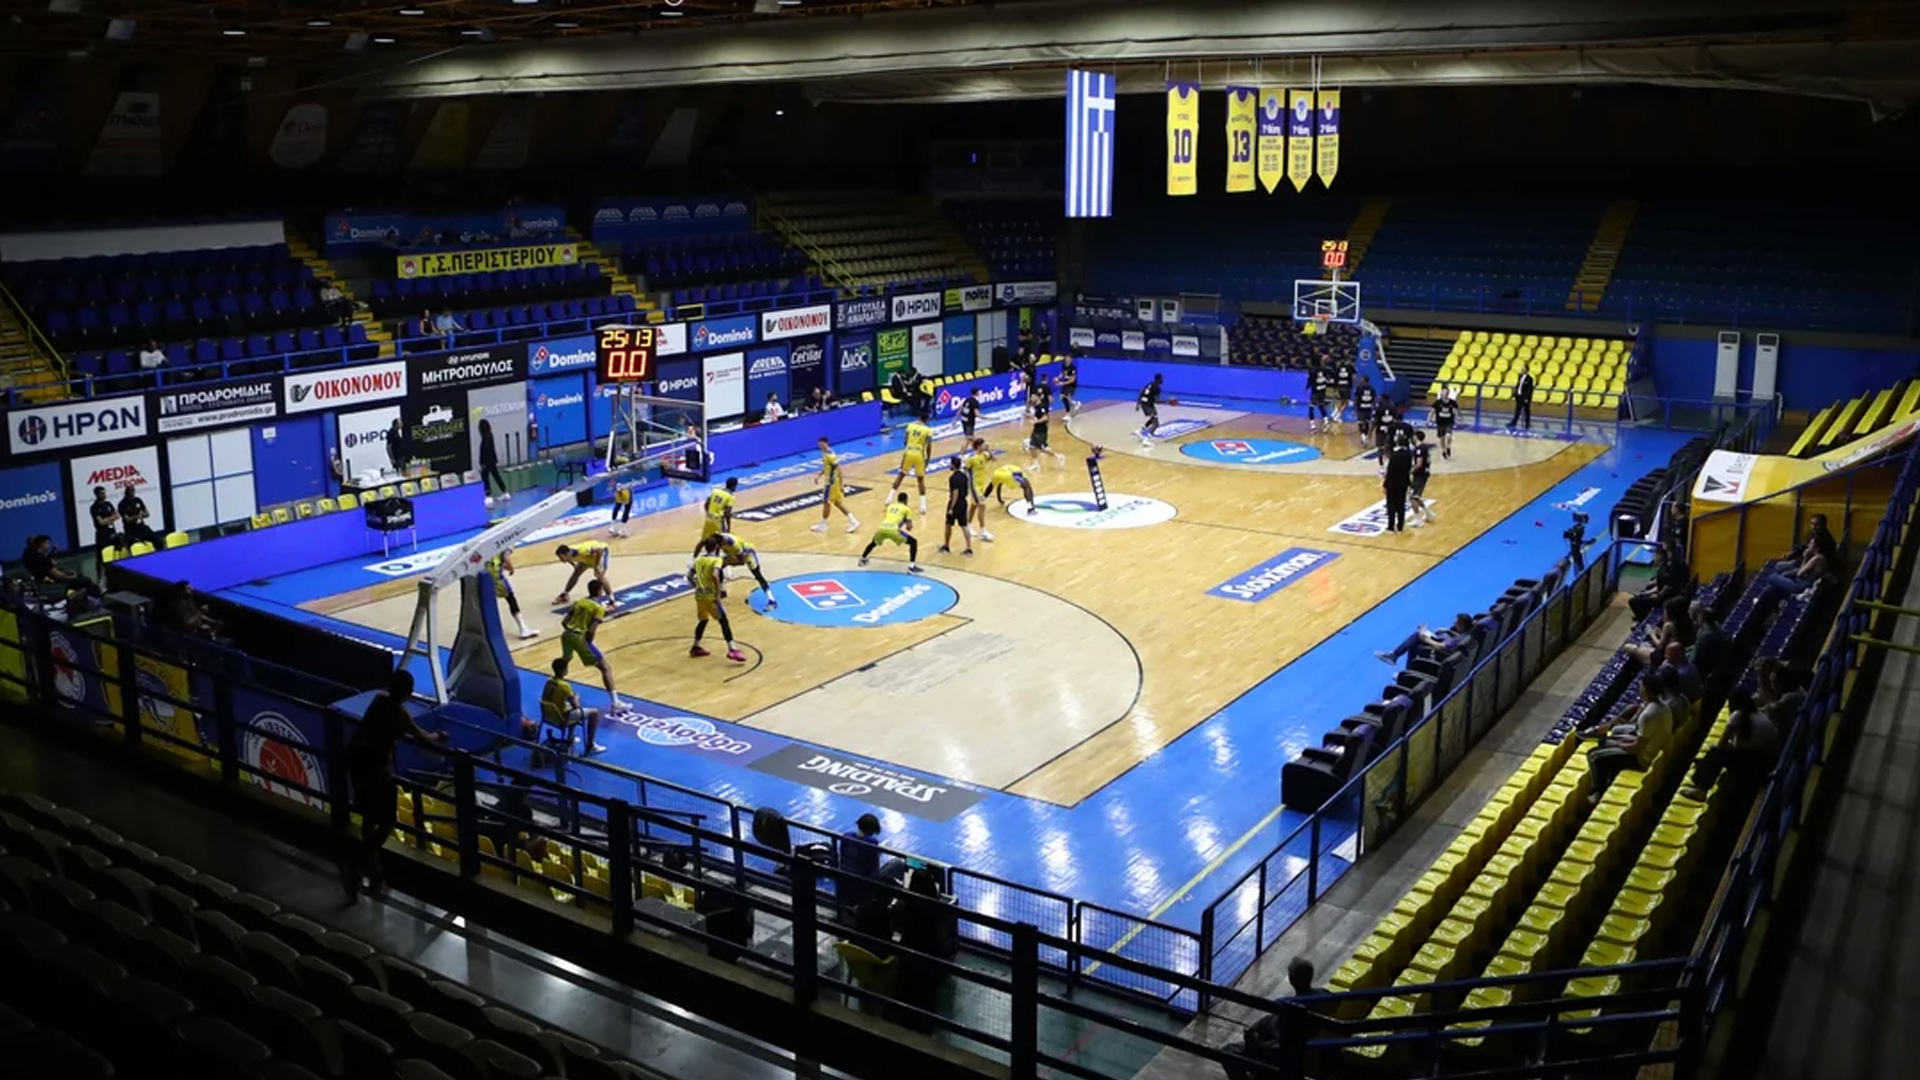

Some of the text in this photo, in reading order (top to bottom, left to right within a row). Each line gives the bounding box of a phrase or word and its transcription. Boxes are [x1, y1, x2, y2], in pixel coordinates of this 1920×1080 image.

[1174, 128, 1192, 164] 10
[1233, 130, 1251, 163] 13
[421, 247, 557, 274] Γ.Σ.ΠΕΡΙΣΤΕΡΙΟΥ
[907, 298, 939, 316] ΗΡΩΝ
[601, 329, 653, 349] 25:13
[708, 327, 754, 346] Domino's
[550, 349, 597, 368] Domino
[608, 350, 647, 378] 0.0
[422, 359, 514, 384] ΜΗΤΡΟΠΟΥΛΟΣ
[179, 383, 273, 406] ΠΡΟΔΡΟΜΙΔΗΣ
[314, 370, 402, 400] ΟΙΚΟΝΟΜΟΥ
[54, 405, 141, 439] ΗΡΩΝ
[198, 406, 273, 423] www.prodromidis.gr
[359, 430, 388, 444] ΗΡΩ
[87, 464, 141, 486] MEDIA
[114, 477, 148, 490] STROM
[851, 582, 933, 624] Domino's
[797, 754, 947, 802] SPALDING
